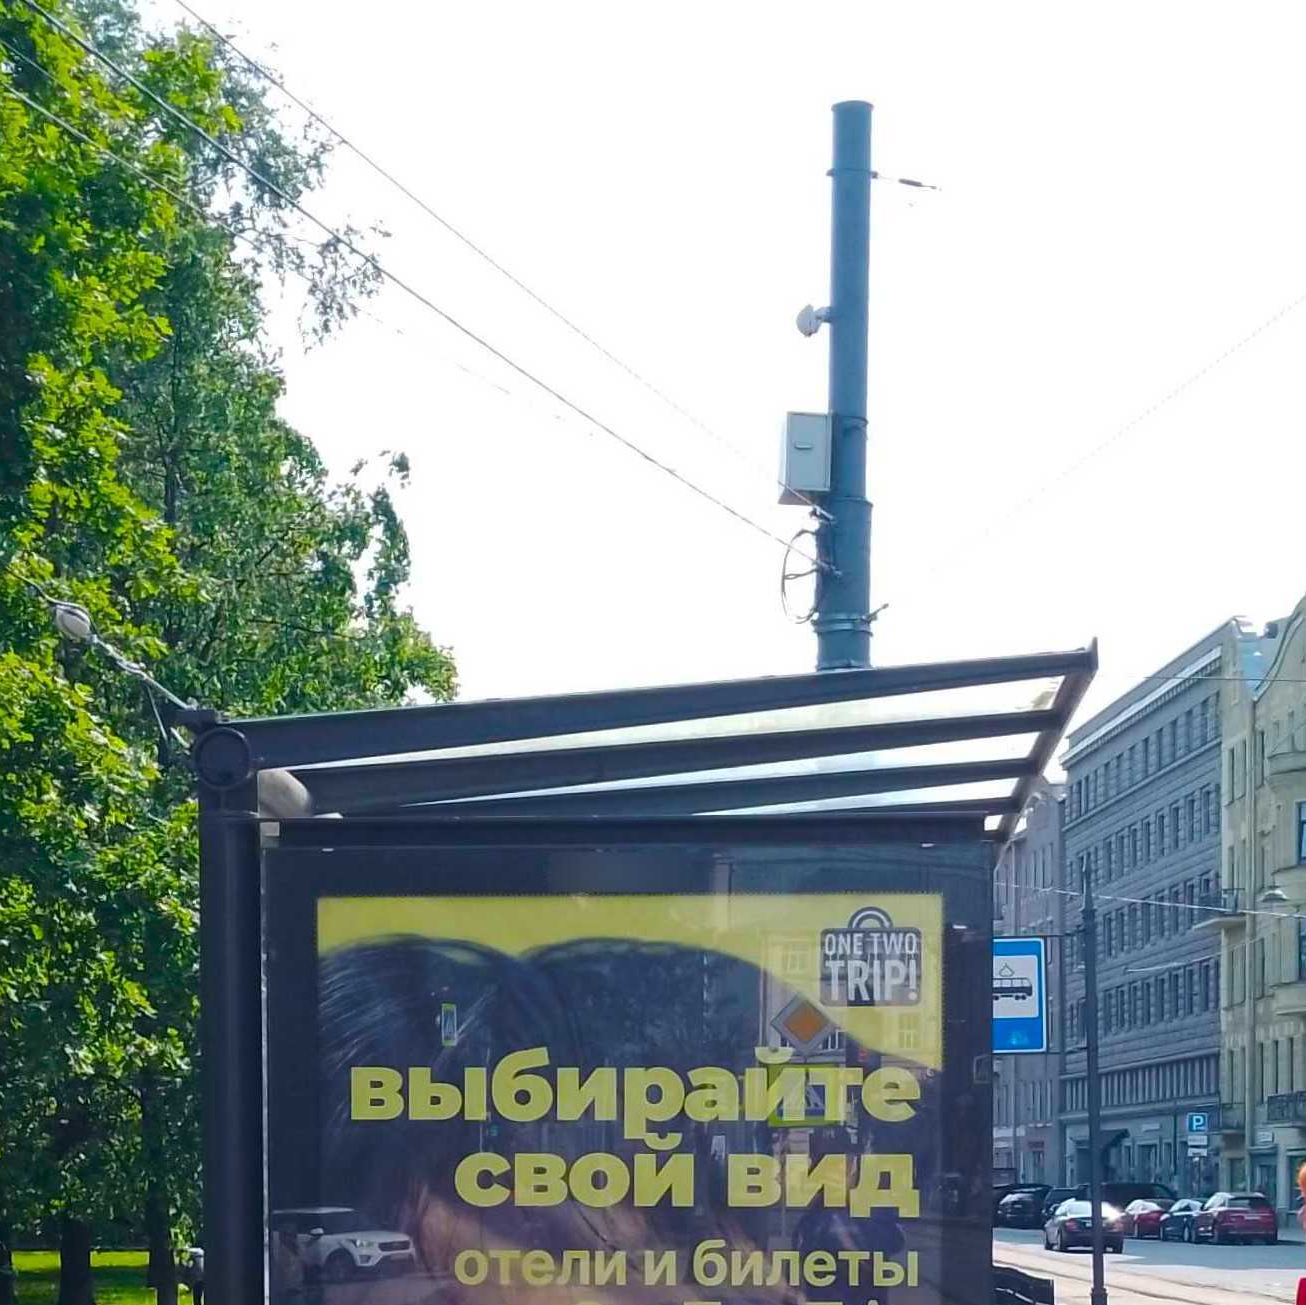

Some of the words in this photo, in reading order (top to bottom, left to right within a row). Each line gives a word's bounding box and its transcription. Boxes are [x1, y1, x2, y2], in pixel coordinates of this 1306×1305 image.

[824, 933, 863, 955] ONE
[870, 933, 918, 955] TWO
[825, 960, 918, 1001] TRIP!
[350, 1047, 919, 1139] выбирайте
[454, 1132, 695, 1207] свой
[727, 1153, 921, 1218] вид
[454, 1248, 627, 1287] отели
[643, 1249, 676, 1286] и
[692, 1239, 919, 1287] билеты
